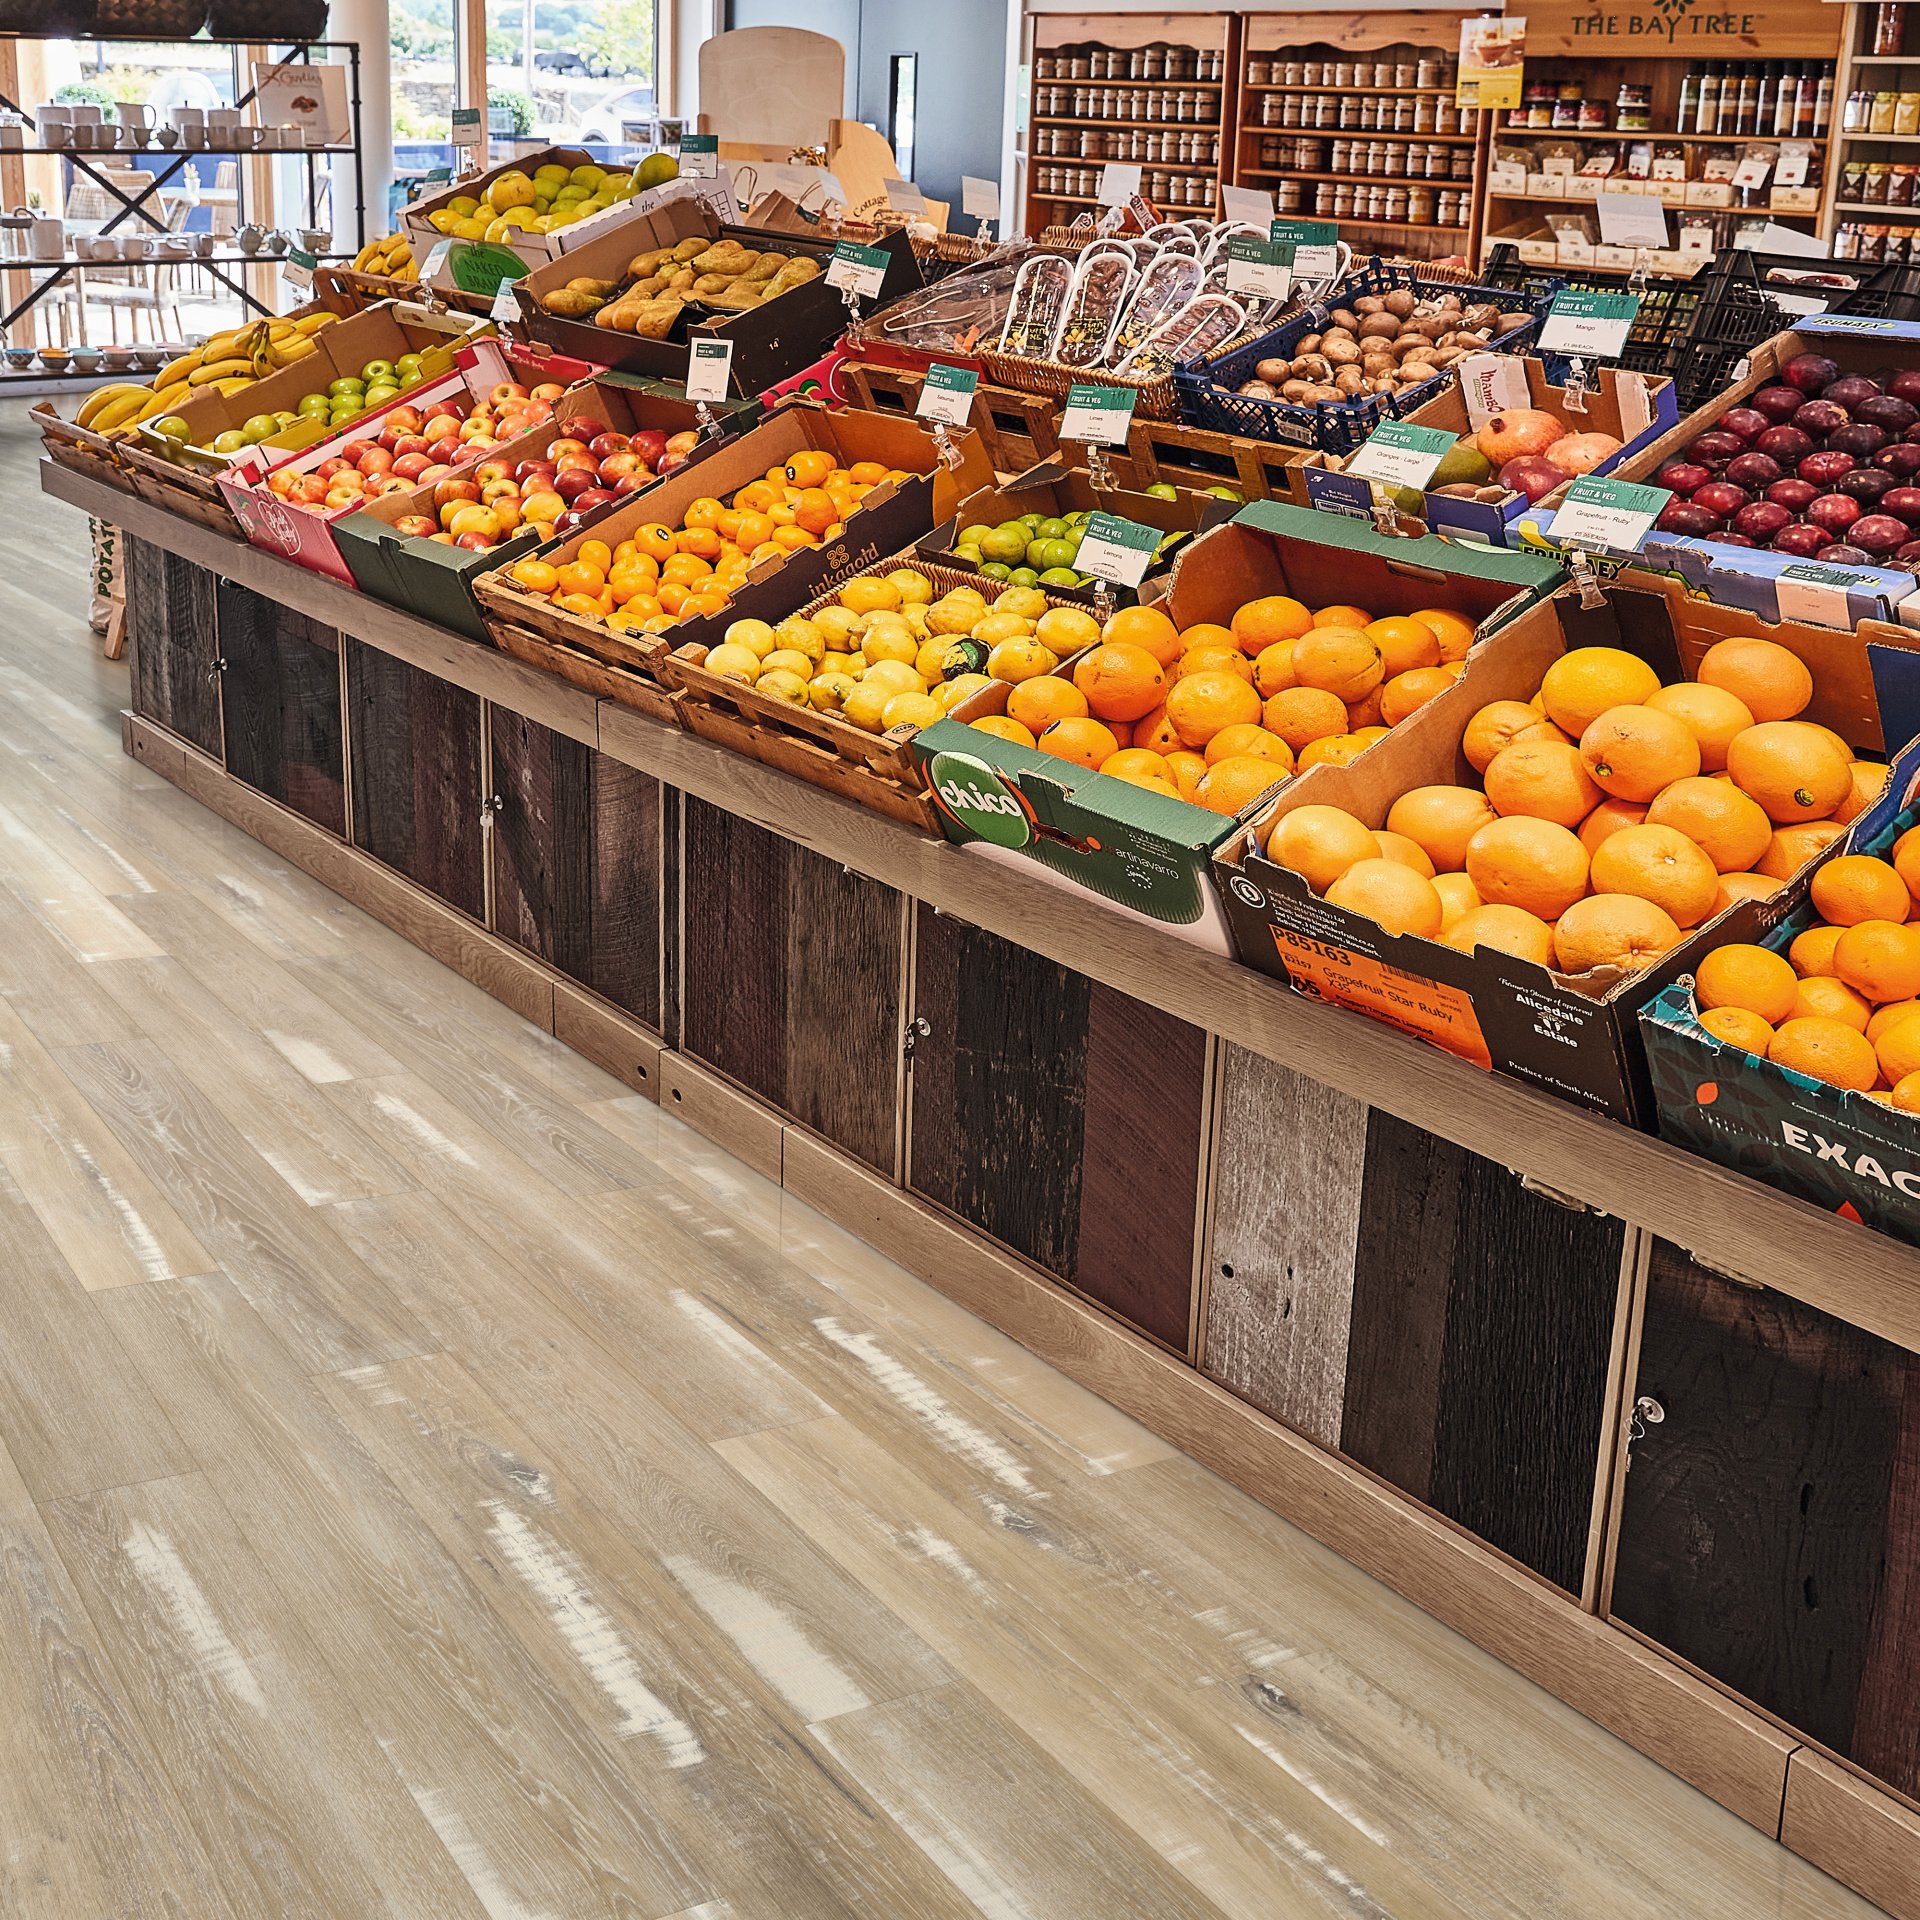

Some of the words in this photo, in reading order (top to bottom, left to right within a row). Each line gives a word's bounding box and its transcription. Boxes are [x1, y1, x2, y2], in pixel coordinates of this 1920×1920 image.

[1571, 16, 1619, 35] THE
[1628, 15, 1681, 43] BAY
[1688, 14, 1756, 34] TREE
[853, 195, 888, 218] Cottage
[1273, 231, 1287, 239] FRUIT
[1231, 247, 1246, 255] FRUIT
[1251, 250, 1262, 258] VEG
[1555, 302, 1573, 310] FRUIT
[1581, 304, 1595, 312] VEG
[1575, 323, 1596, 331] Mango
[1070, 395, 1085, 403] FRUIT
[1374, 431, 1393, 440] FRUIT
[1399, 435, 1413, 443] VEG
[1376, 450, 1400, 461] Oranges
[1403, 456, 1421, 466] Large
[1573, 487, 1594, 497] FRUIT
[1594, 491, 1601, 499] &
[1601, 492, 1617, 501] VEG
[1575, 509, 1608, 521] Grapefruit
[1612, 516, 1632, 525] Ruby
[1089, 523, 1106, 534] FRUIT
[1111, 529, 1123, 539] VEG
[1103, 549, 1123, 560] Lemons
[940, 779, 1023, 817] chico
[1272, 926, 1352, 967] P85163
[1322, 966, 1387, 999] Grapefruit
[1387, 990, 1415, 1009] Star
[1418, 1001, 1453, 1023] Ruby
[1515, 993, 1585, 1026] Alicedale
[1533, 1023, 1579, 1048] Estate
[1508, 1060, 1543, 1079] Produce
[1544, 1076, 1554, 1084] of
[1555, 1079, 1582, 1095] South
[1583, 1090, 1610, 1106] Africa
[1780, 1119, 1920, 1201] EXAC
